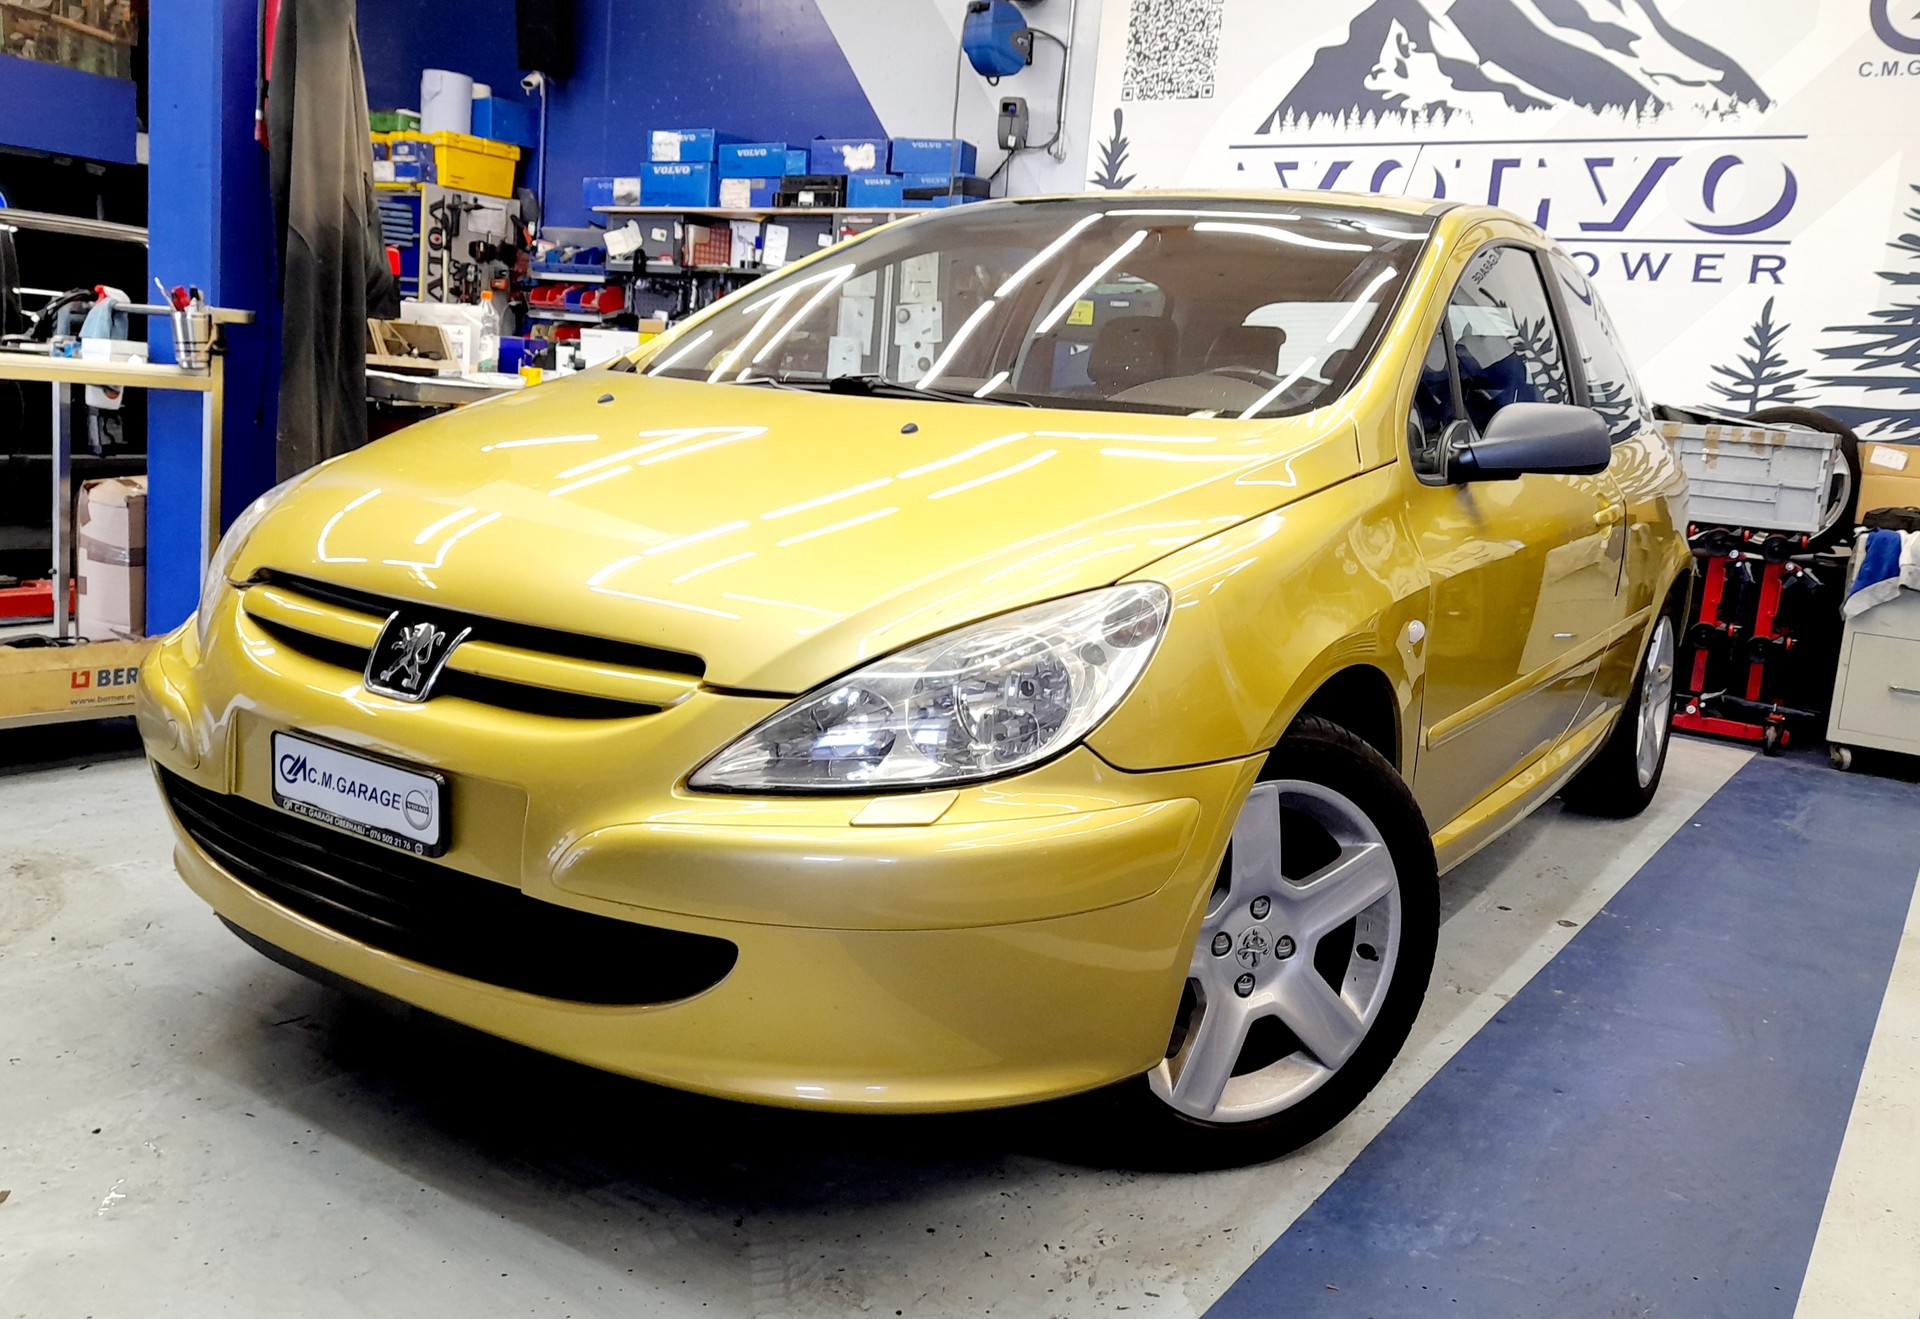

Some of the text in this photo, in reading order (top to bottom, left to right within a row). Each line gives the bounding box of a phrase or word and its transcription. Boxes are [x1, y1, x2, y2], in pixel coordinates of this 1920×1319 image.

[912, 141, 942, 150] VOLVO
[737, 148, 767, 158] VOLVO
[653, 164, 691, 176] VOLVO
[864, 178, 891, 187] VOLVO
[920, 176, 948, 185] VOLVO
[307, 766, 401, 811] C.M.GARAGE
[406, 801, 429, 814] VOLVO
[308, 809, 334, 825] GARAGE
[369, 829, 381, 841] 076
[381, 832, 394, 845] 502
[394, 836, 402, 847] 21
[403, 840, 411, 850] 76
